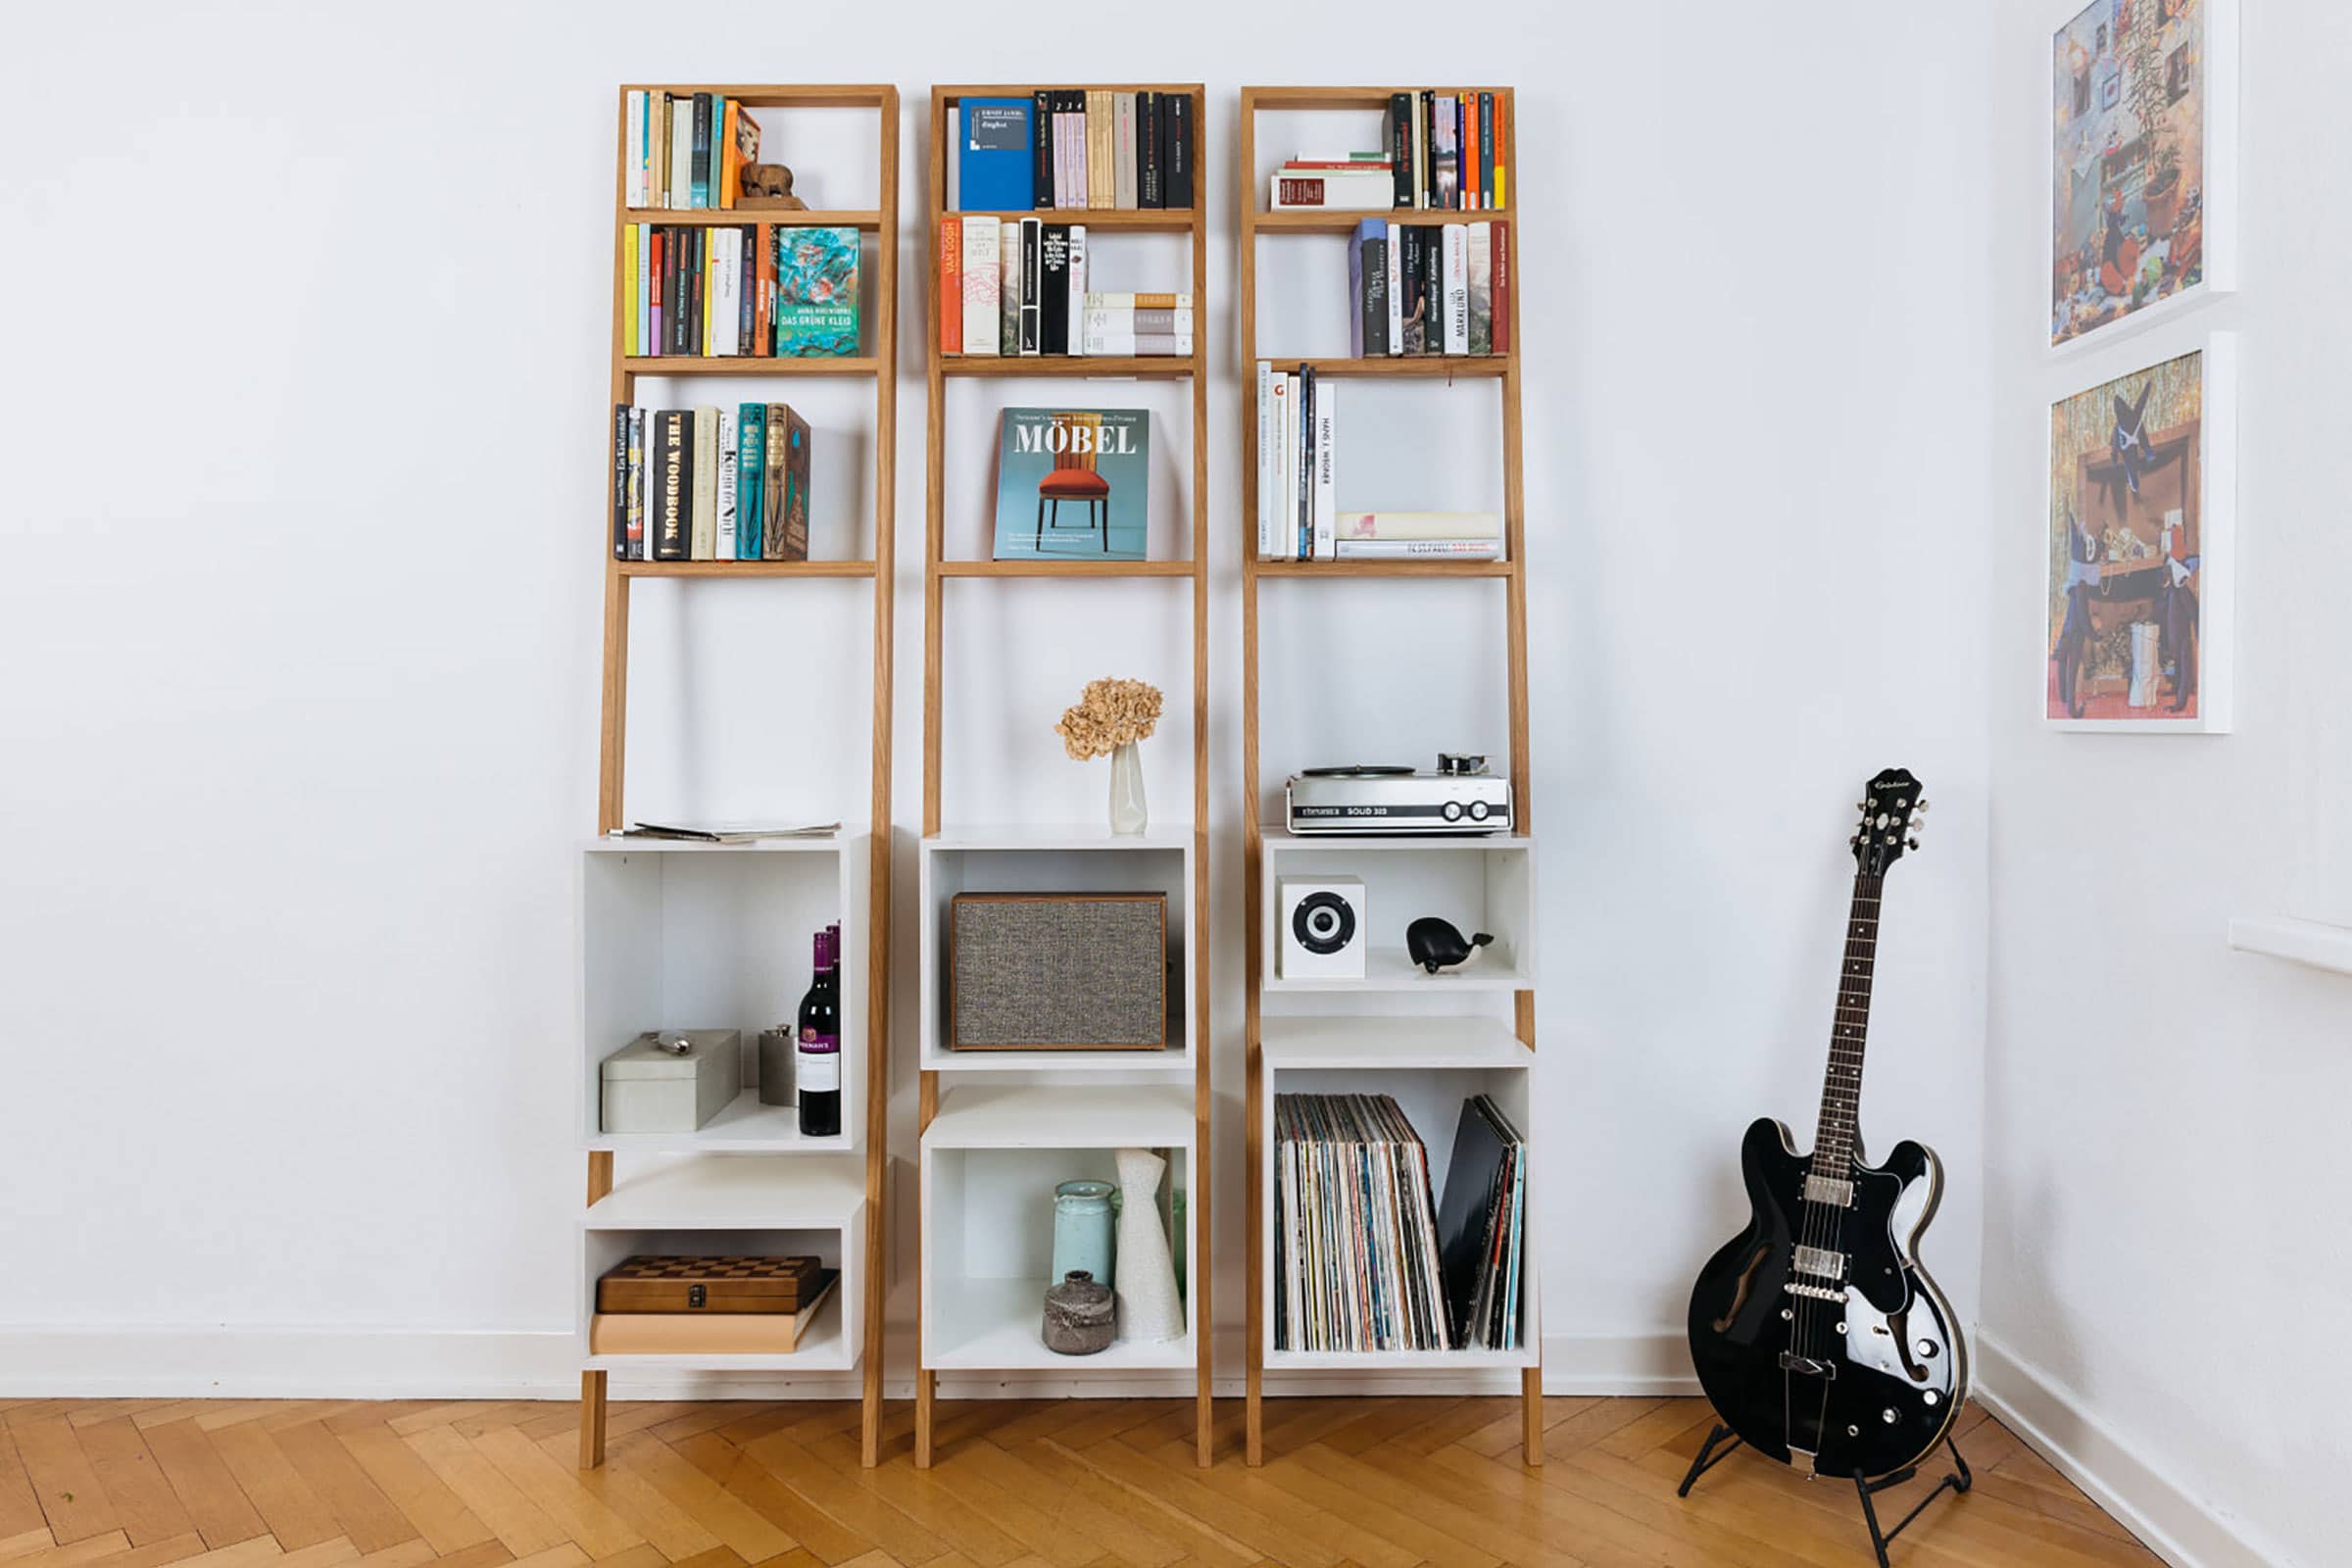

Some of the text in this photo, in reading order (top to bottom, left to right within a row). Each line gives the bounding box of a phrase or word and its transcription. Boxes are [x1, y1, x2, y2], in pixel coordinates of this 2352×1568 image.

[946, 222, 955, 273] VAN GOGH
[781, 316, 852, 325] DAS GRÜNE KLEID
[1454, 289, 1465, 337] MARKLUND
[1014, 421, 1137, 454] MÖBEL
[665, 414, 680, 539] THE WOODBOOK
